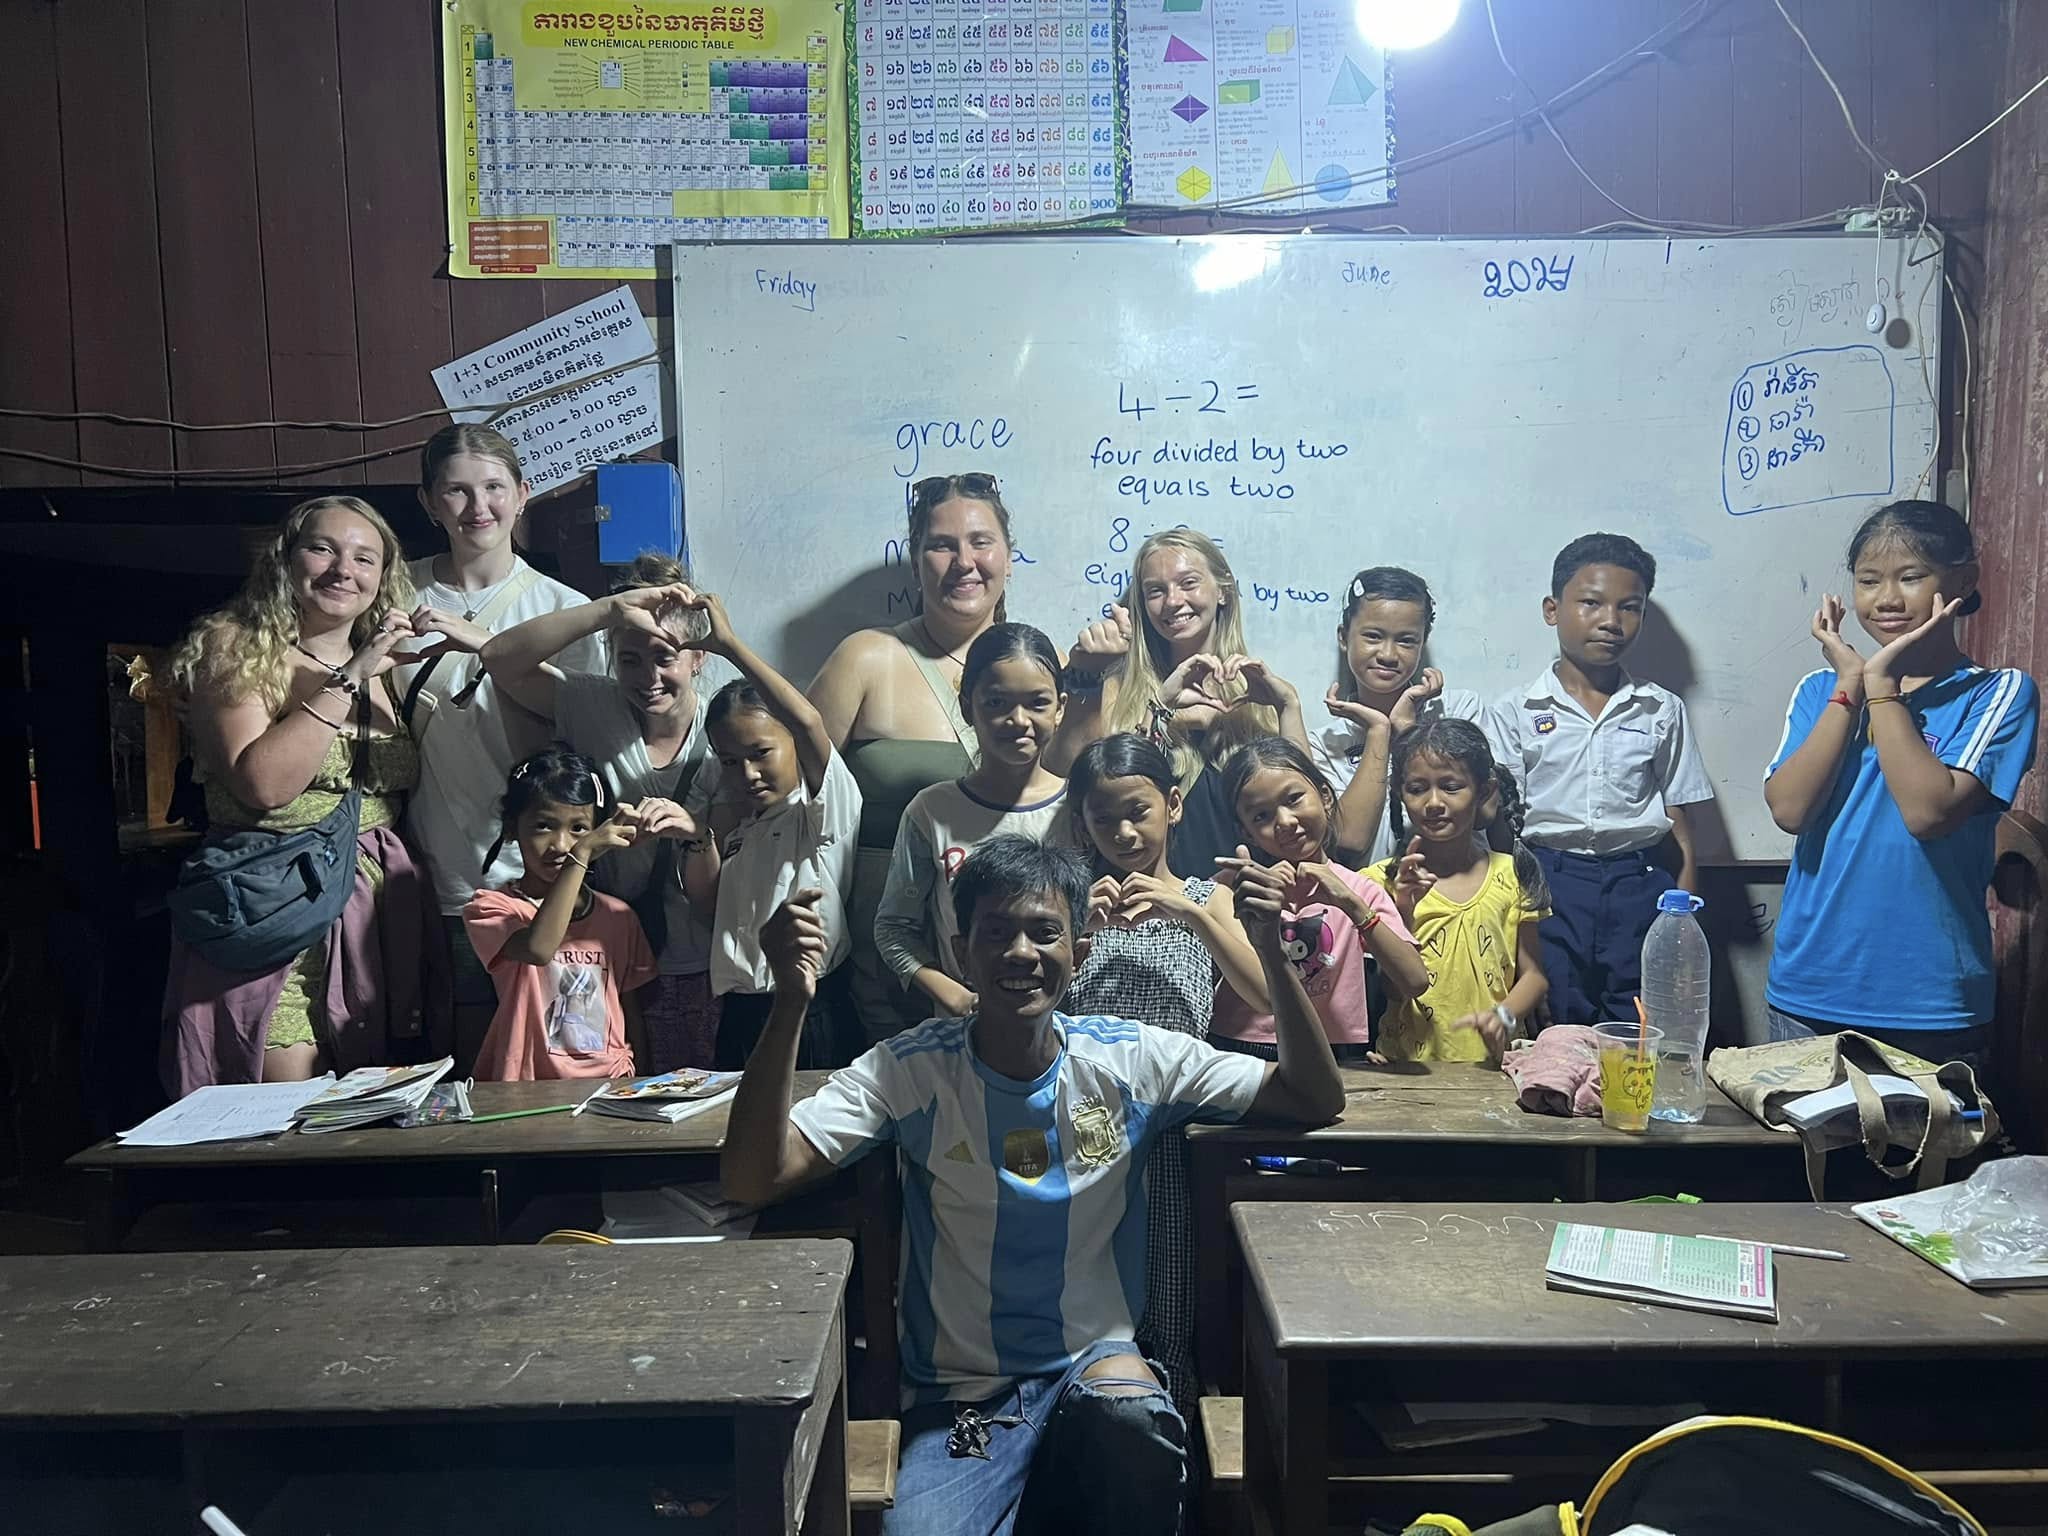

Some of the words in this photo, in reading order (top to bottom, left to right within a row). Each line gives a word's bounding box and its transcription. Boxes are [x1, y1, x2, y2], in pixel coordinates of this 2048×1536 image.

[464, 42, 470, 51] 1
[564, 39, 588, 47] NEW
[591, 39, 645, 48] CHEMICAL
[648, 40, 698, 49] PERIODIC
[702, 40, 735, 49] TABLE
[465, 67, 472, 77] 2
[466, 93, 473, 102] 3
[467, 120, 474, 129] 4
[468, 147, 475, 157] 5
[468, 172, 475, 181] 6
[469, 197, 475, 207] 7
[756, 269, 816, 312] Friday
[453, 363, 481, 383] 1+3
[484, 323, 571, 370] Community
[574, 298, 626, 330] School
[462, 384, 483, 400] 1+3
[893, 417, 1014, 477] grace
[1090, 436, 1142, 470] four
[1153, 439, 1238, 463] divided
[1252, 438, 1286, 473] by
[1297, 439, 1349, 458] two
[1118, 474, 1210, 504] equals
[1229, 476, 1295, 499] two
[1254, 583, 1281, 611] by
[1285, 587, 1329, 603] two
[1018, 1164, 1039, 1173] FIFA
